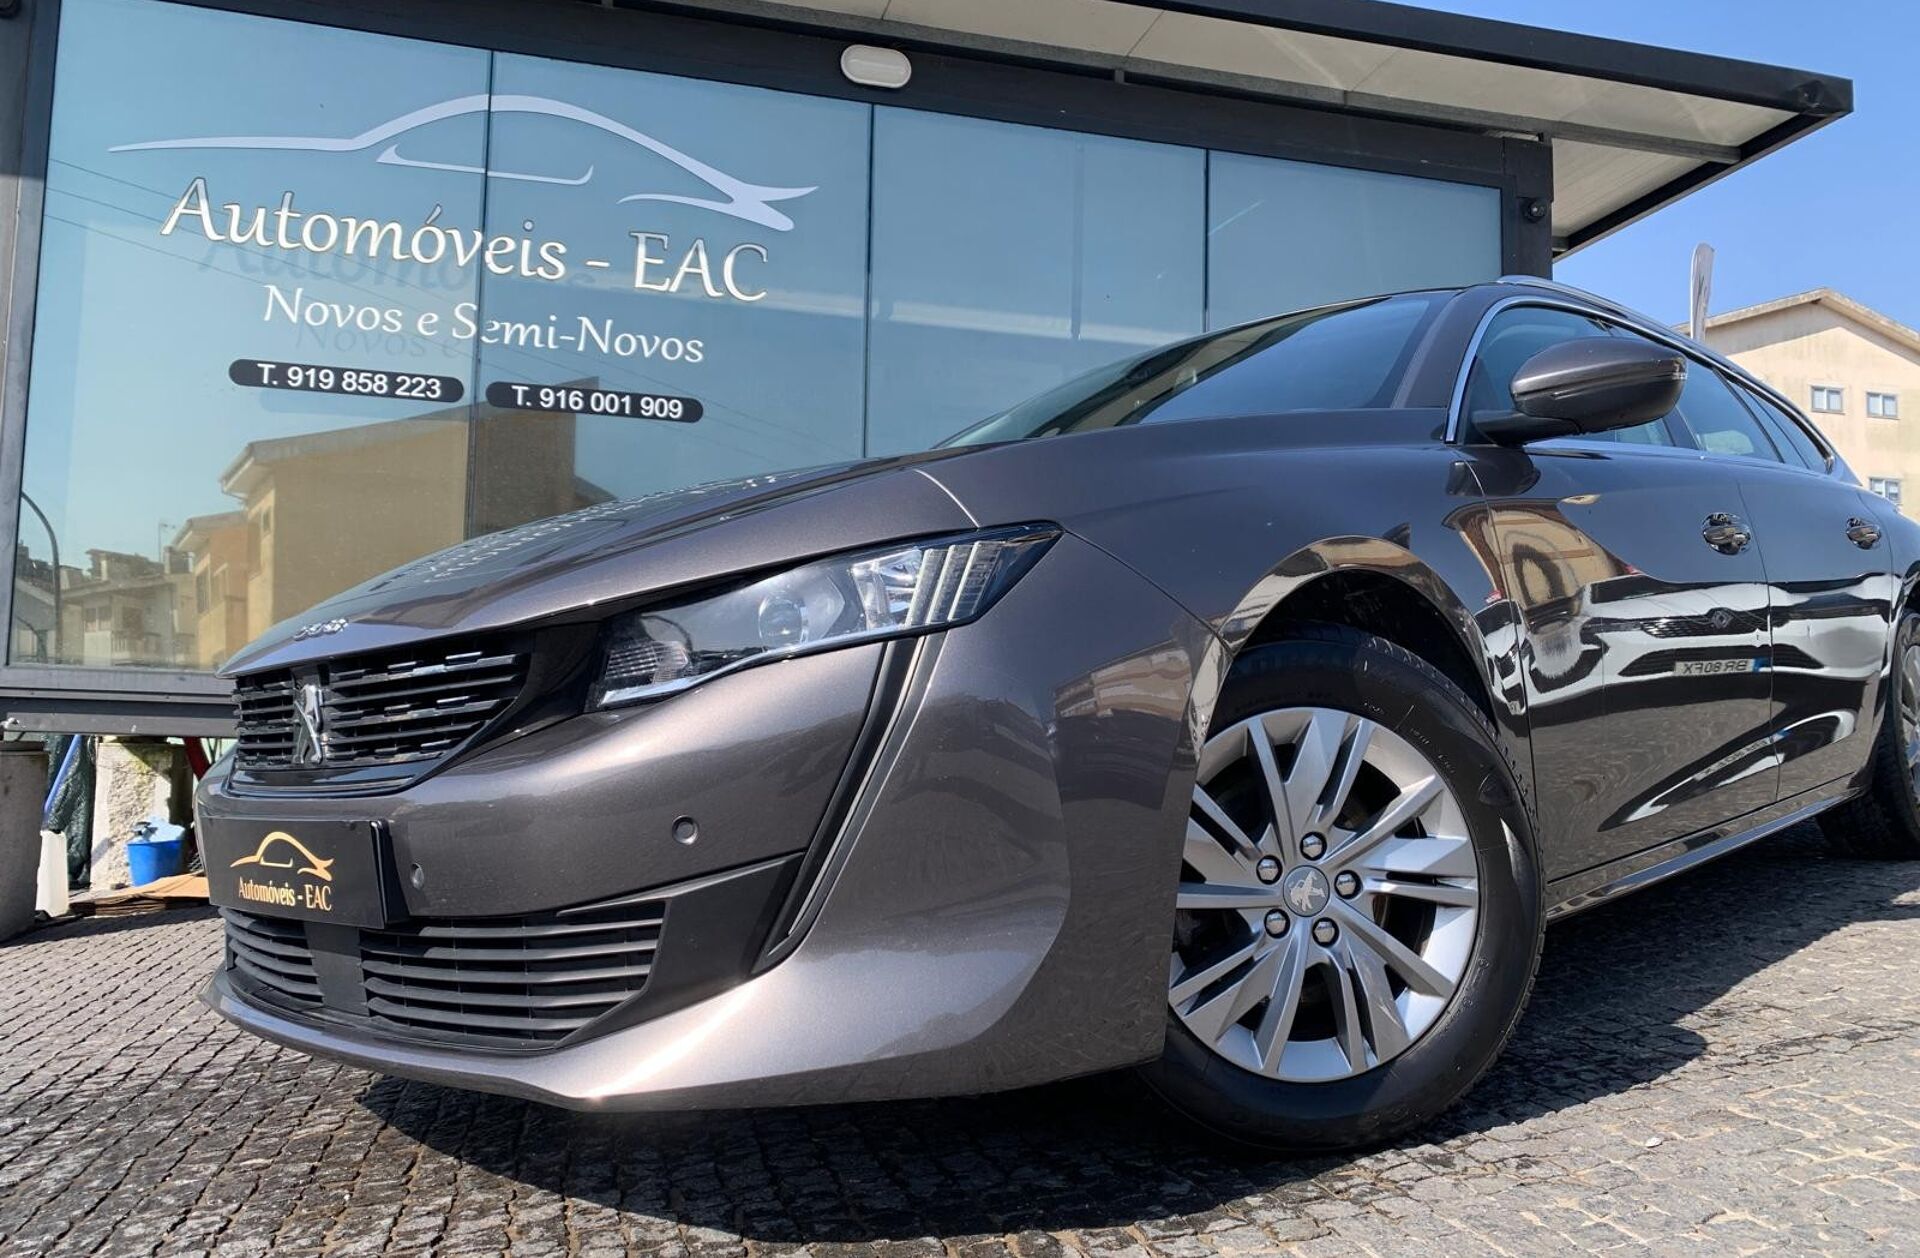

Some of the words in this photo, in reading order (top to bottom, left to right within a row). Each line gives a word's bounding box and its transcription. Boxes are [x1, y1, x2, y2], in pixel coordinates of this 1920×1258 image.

[160, 177, 567, 279] Automóveis
[629, 231, 768, 300] EAC
[263, 285, 402, 332] Novos
[417, 312, 439, 335] e
[452, 302, 704, 362] Semi-Novos
[257, 363, 277, 385] T.
[287, 366, 334, 389] 919
[341, 371, 388, 394] 858
[395, 376, 441, 398] 223
[511, 385, 532, 407] T.
[539, 388, 584, 410] 916
[590, 392, 632, 414] 001
[640, 396, 683, 419] 909
[239, 876, 296, 906] Automóveis
[304, 884, 332, 911] EAC
